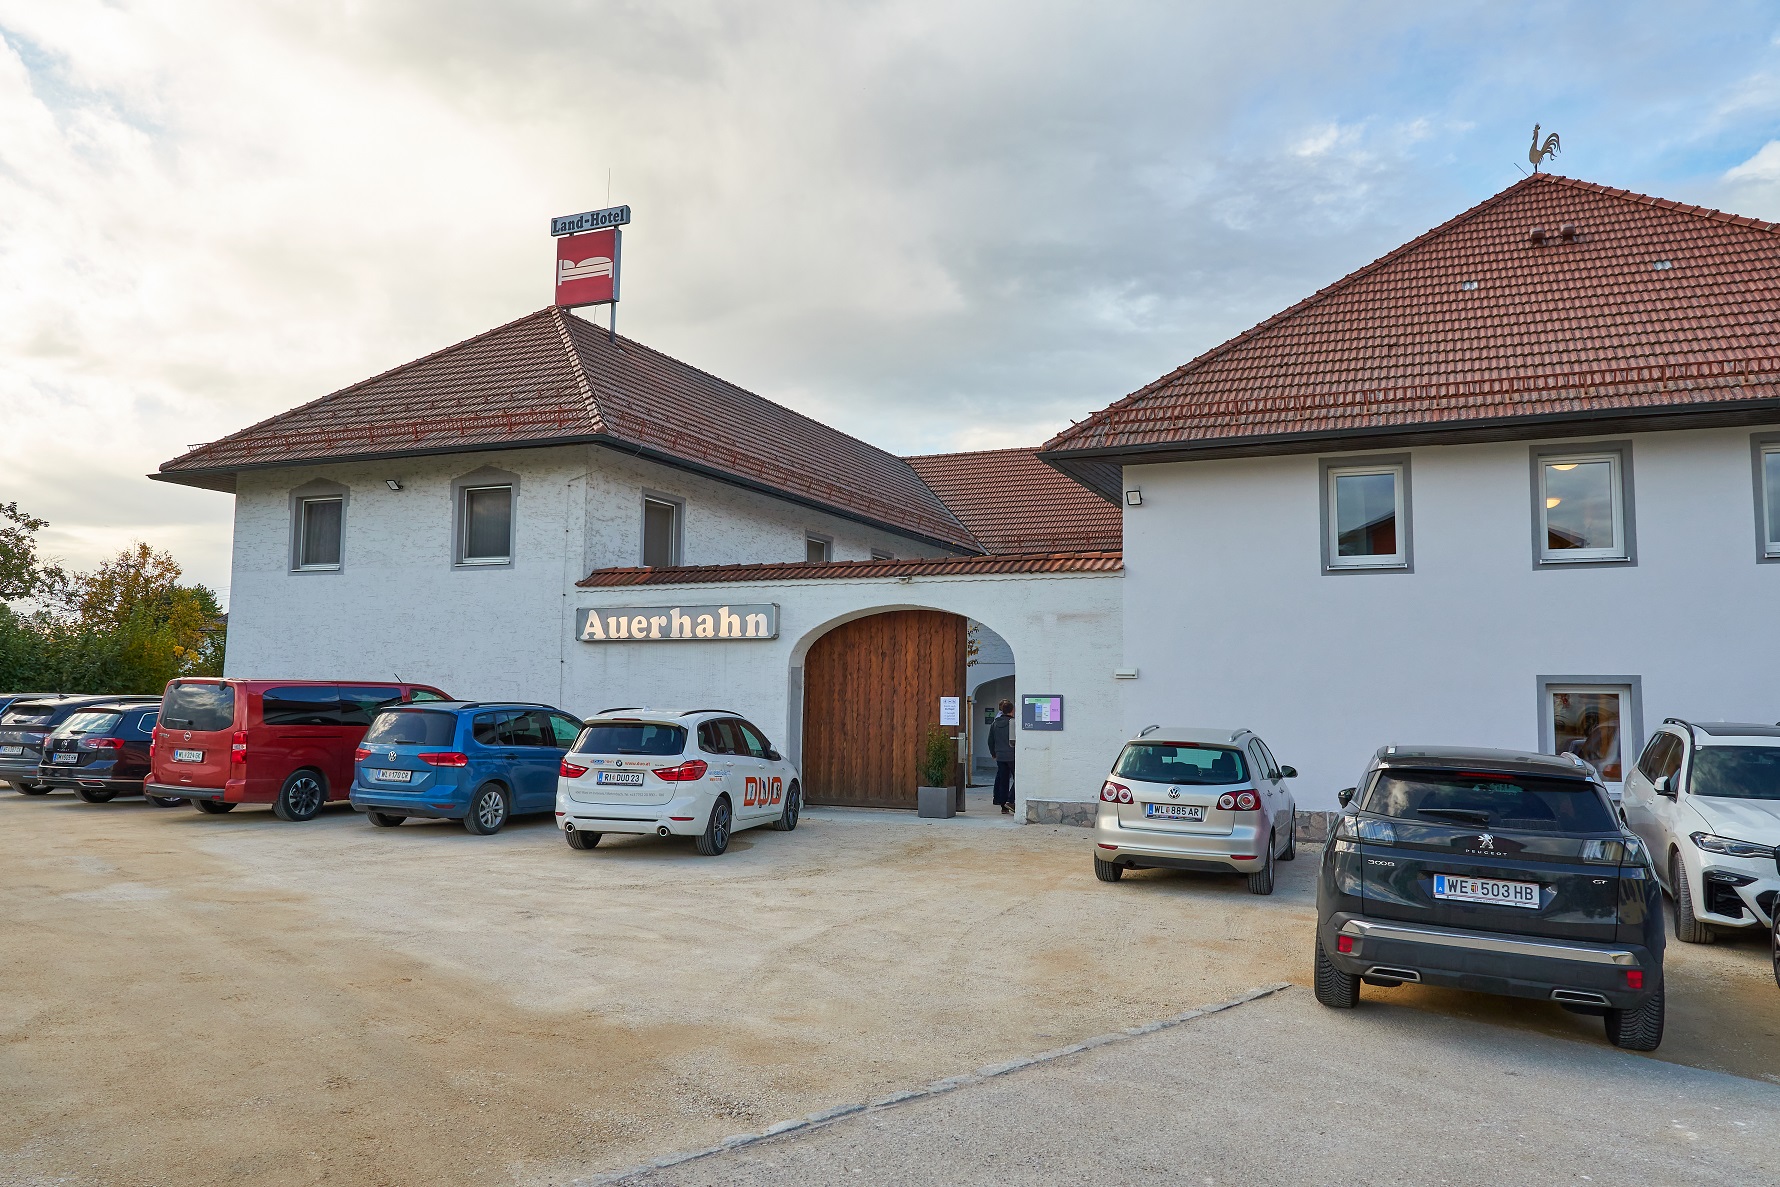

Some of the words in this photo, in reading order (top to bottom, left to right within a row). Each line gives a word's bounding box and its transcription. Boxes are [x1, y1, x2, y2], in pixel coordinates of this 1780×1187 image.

[552, 208, 625, 234] Land-Hotel
[580, 606, 769, 639] Auerhahn
[604, 773, 612, 782] RI
[616, 774, 630, 782] DUO
[631, 774, 640, 782] 23
[743, 776, 783, 807] DUO
[1154, 805, 1165, 814] WL
[1171, 806, 1187, 815] 885
[1188, 807, 1199, 817] AR
[1465, 848, 1508, 856] PEUGEOT
[1367, 859, 1395, 867] 3008
[1447, 878, 1469, 894] WE
[1480, 882, 1510, 898] 503
[1514, 885, 1534, 901] HB
